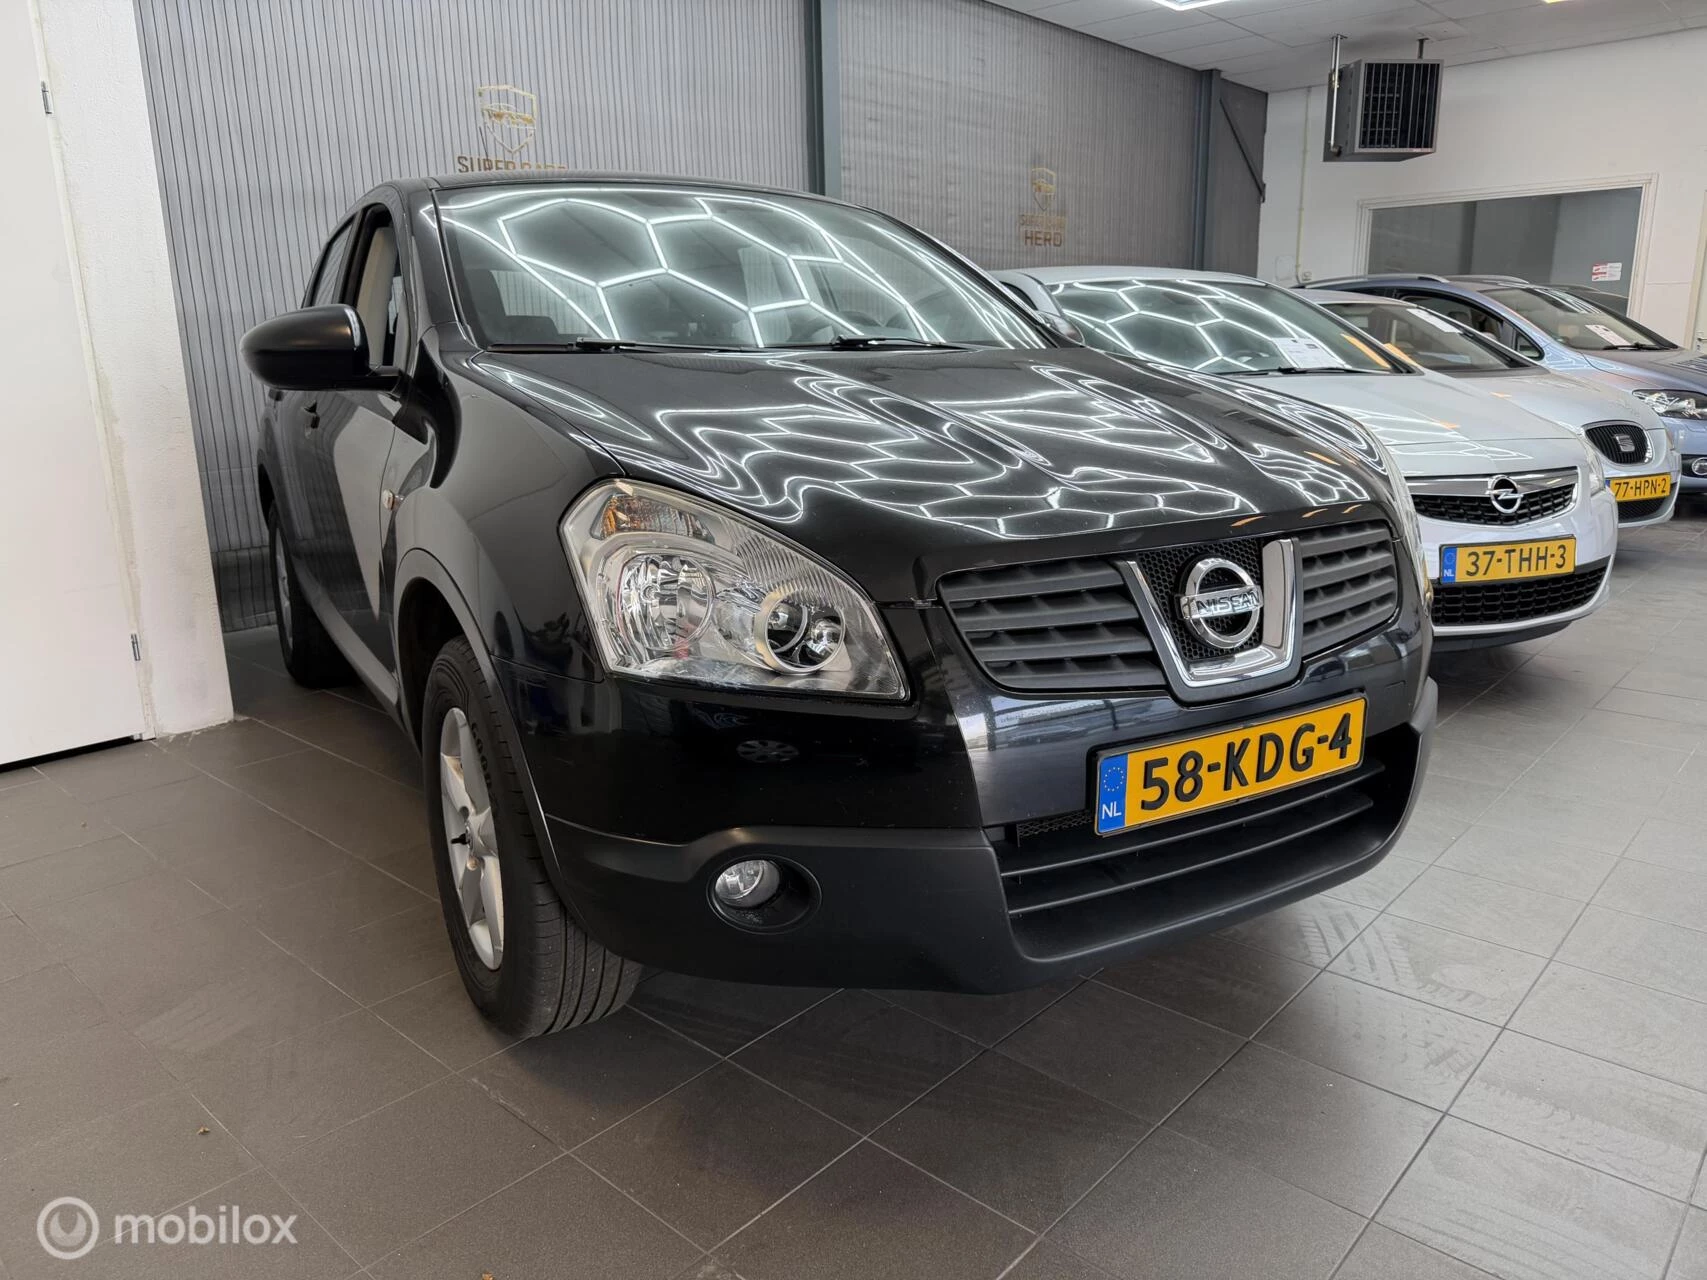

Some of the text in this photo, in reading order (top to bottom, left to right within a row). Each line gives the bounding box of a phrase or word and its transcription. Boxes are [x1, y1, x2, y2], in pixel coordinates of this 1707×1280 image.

[1024, 229, 1063, 247] HERO
[1614, 478, 1667, 498] 77-HPN-2
[1443, 544, 1567, 577] NL 37-THH-3
[1195, 590, 1260, 614] NISSAN
[1101, 712, 1352, 819] NL 58-KDG-4
